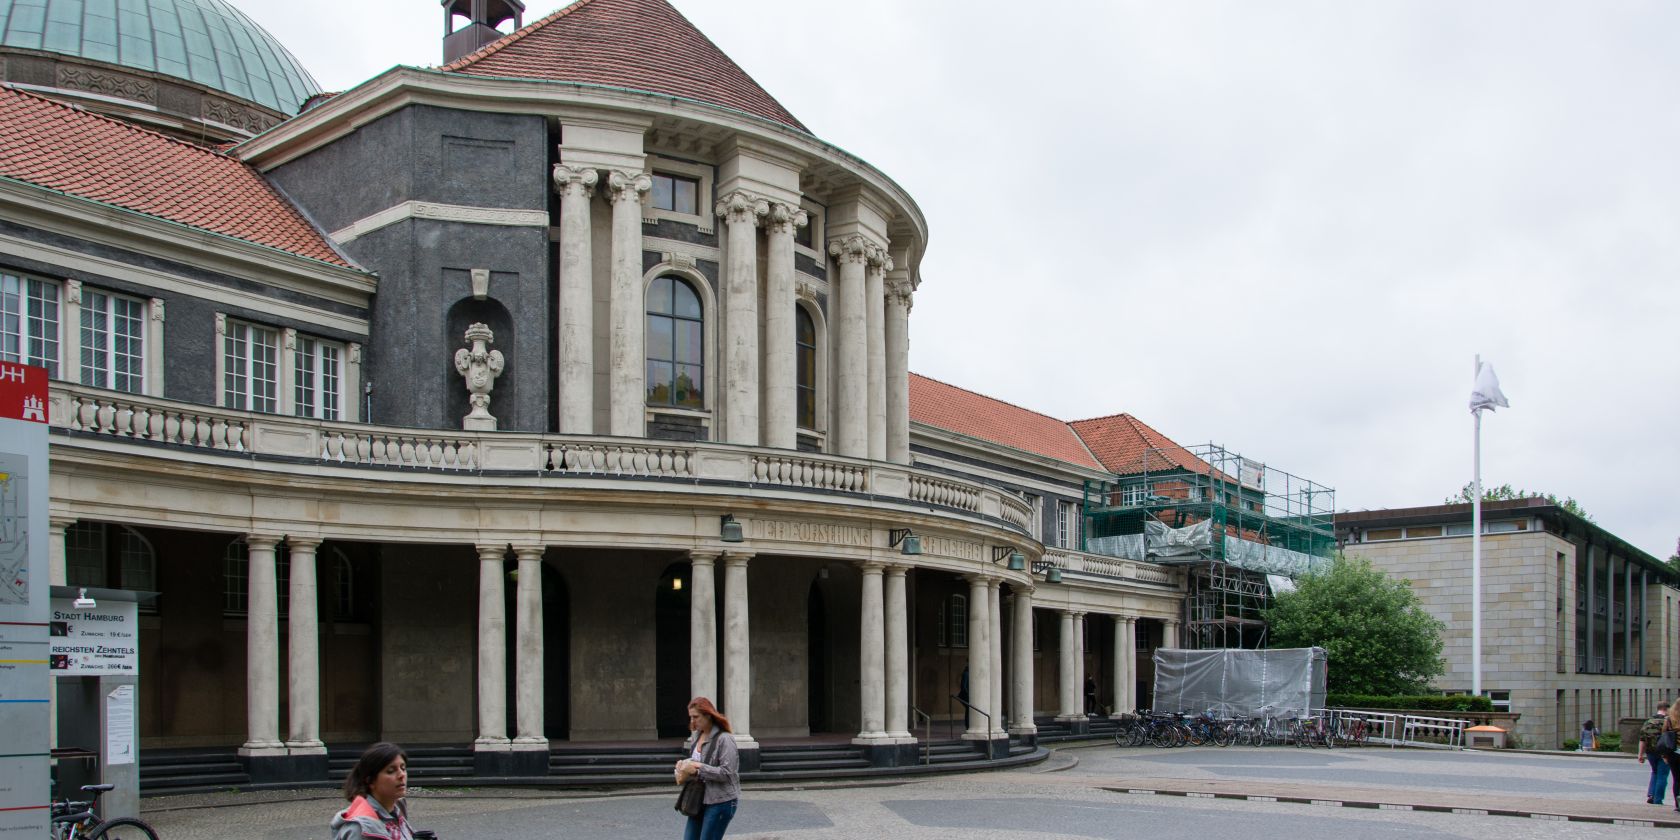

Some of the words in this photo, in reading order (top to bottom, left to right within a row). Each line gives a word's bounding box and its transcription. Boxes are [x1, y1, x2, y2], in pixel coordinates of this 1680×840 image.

[789, 521, 871, 546] FORSCHUNG
[54, 611, 81, 620] STADT
[84, 612, 125, 622] HAMBURG
[96, 645, 135, 654] ZEHNTELS
